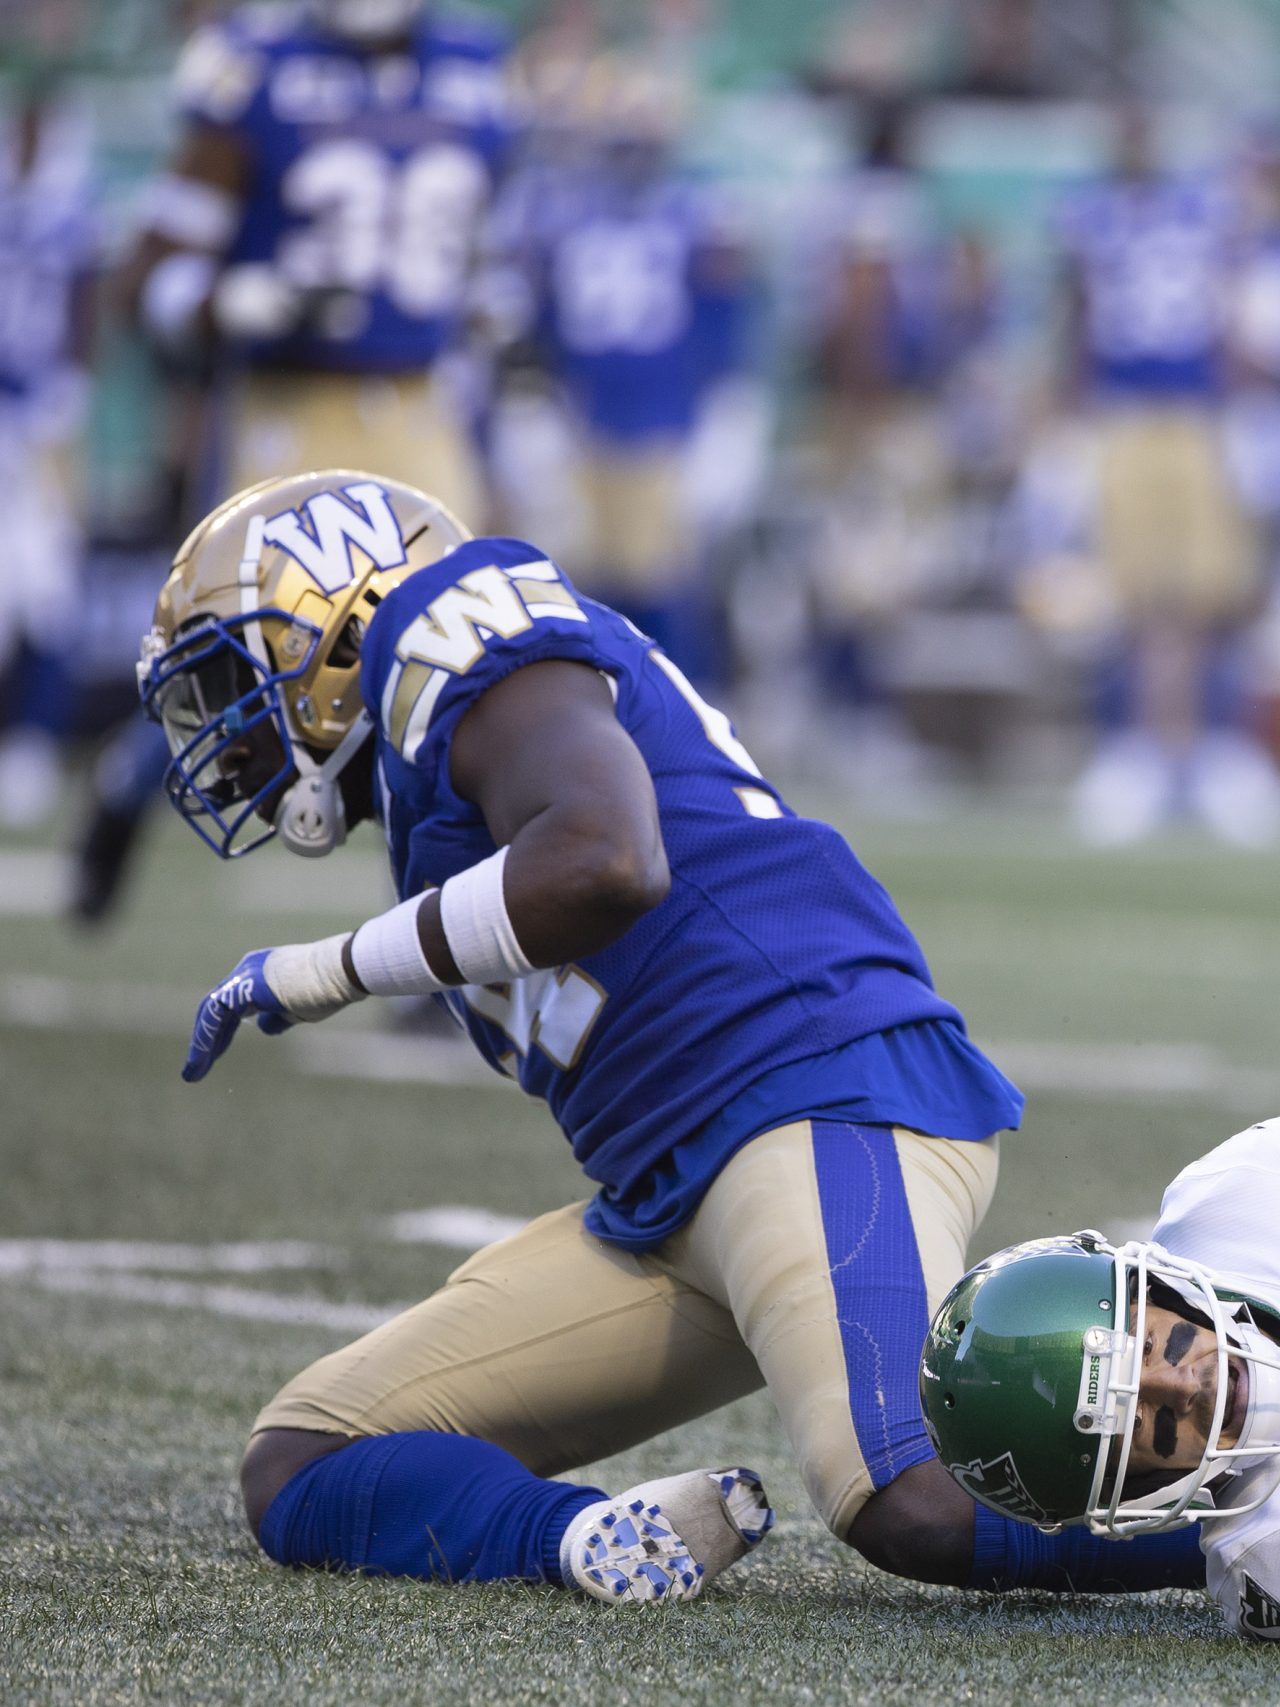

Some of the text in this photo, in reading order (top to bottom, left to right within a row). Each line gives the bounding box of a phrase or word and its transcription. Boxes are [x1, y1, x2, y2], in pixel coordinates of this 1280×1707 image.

[263, 481, 408, 597] W
[395, 564, 534, 675] W
[1087, 1355, 1100, 1405] RIDERS
